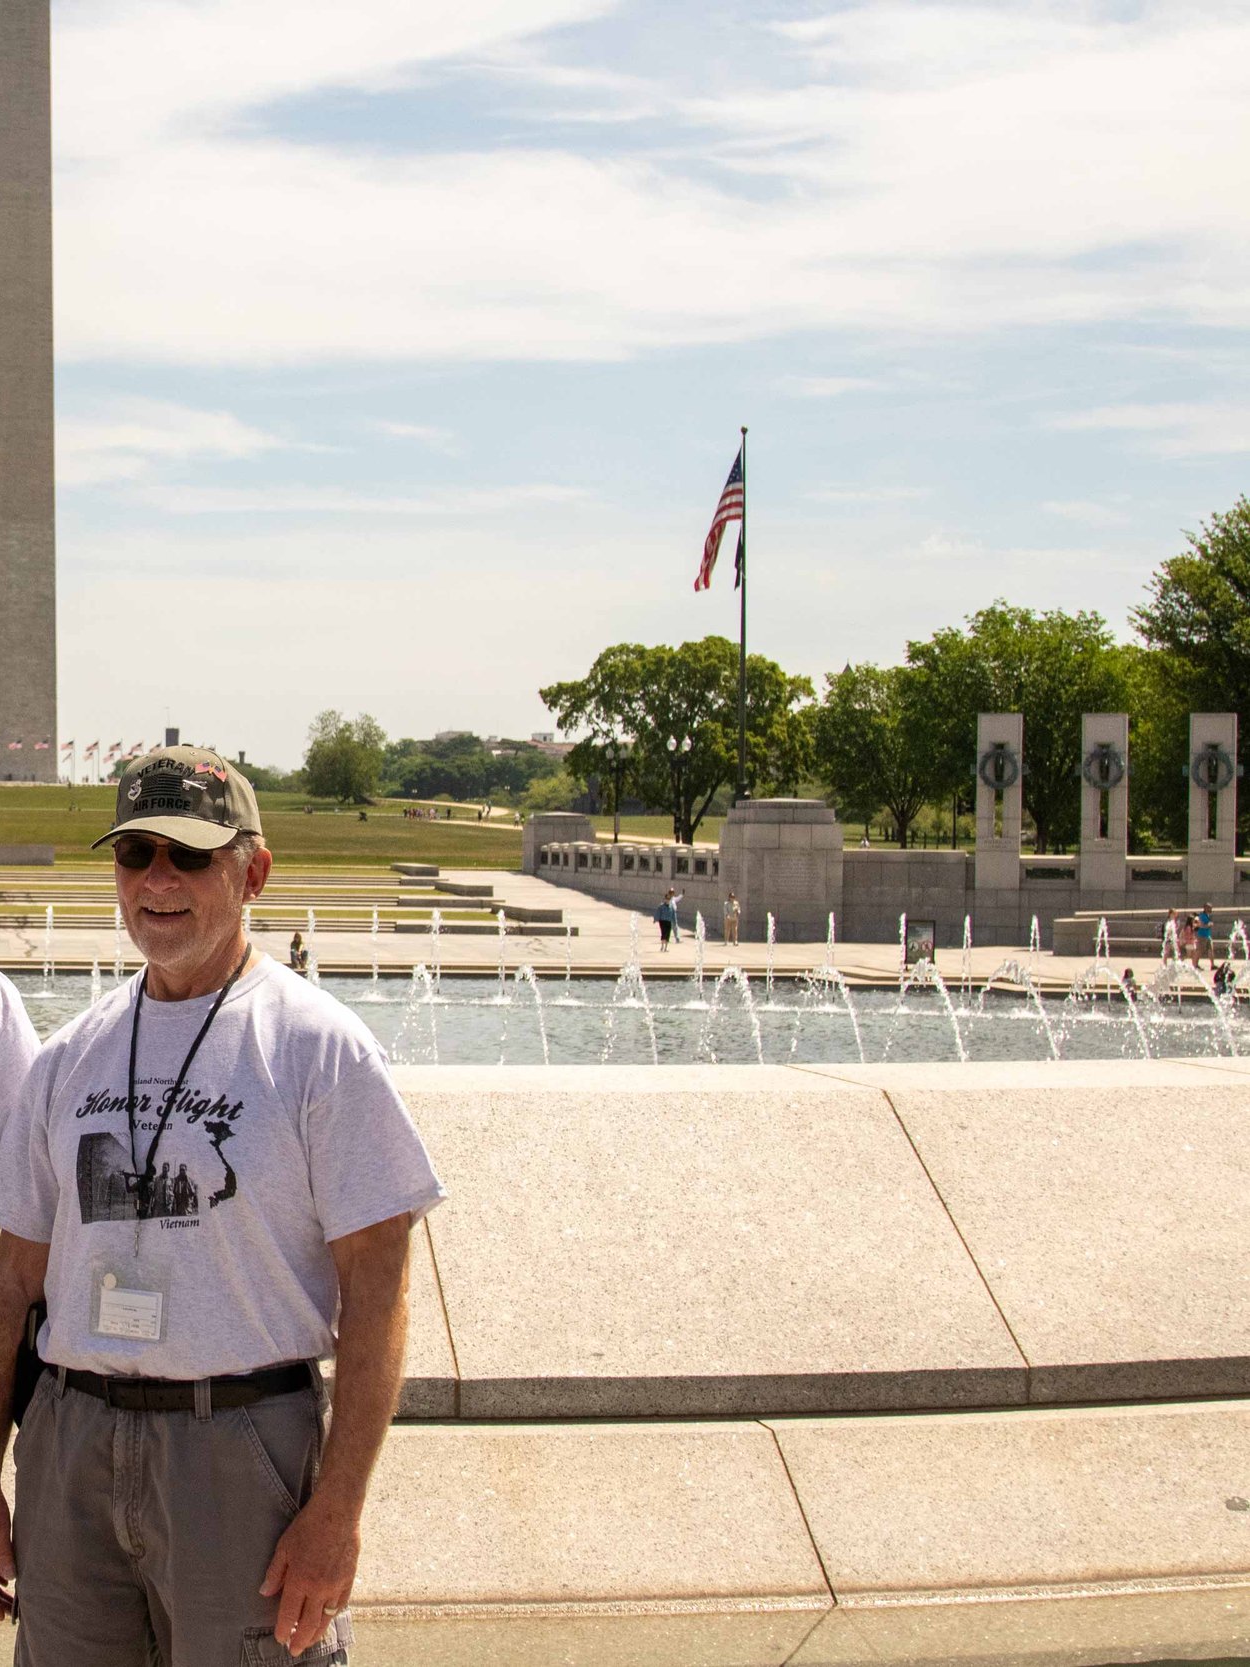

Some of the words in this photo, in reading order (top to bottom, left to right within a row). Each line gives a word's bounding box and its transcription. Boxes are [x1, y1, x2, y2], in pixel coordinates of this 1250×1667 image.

[137, 758, 197, 778] VETERAN
[132, 800, 148, 814] AIR
[151, 798, 191, 811] FORCE
[133, 1077, 152, 1085] nland
[153, 1077, 189, 1085] Northst
[76, 1088, 151, 1118] Honor
[156, 1087, 245, 1124] Flight
[133, 1119, 173, 1131] Veten
[160, 1218, 200, 1230] Vietnam
